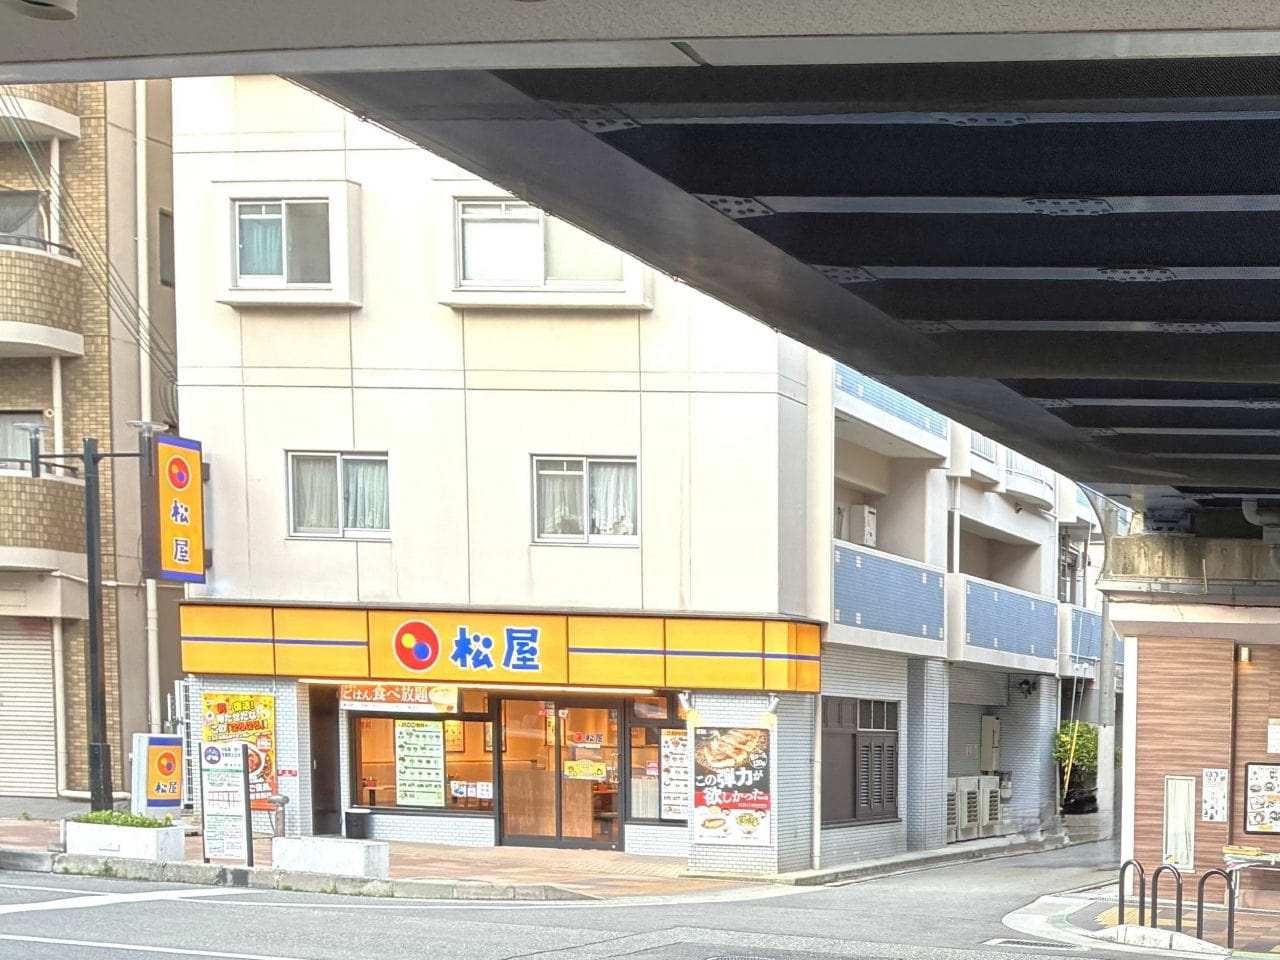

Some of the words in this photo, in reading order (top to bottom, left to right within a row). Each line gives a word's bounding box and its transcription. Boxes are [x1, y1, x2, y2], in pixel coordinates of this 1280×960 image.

[172, 499, 190, 564] 松屋
[450, 626, 540, 671] 松屋
[343, 685, 428, 702] ごはん食べ放題
[154, 781, 177, 794] 松屋
[695, 766, 763, 788] この弾力が
